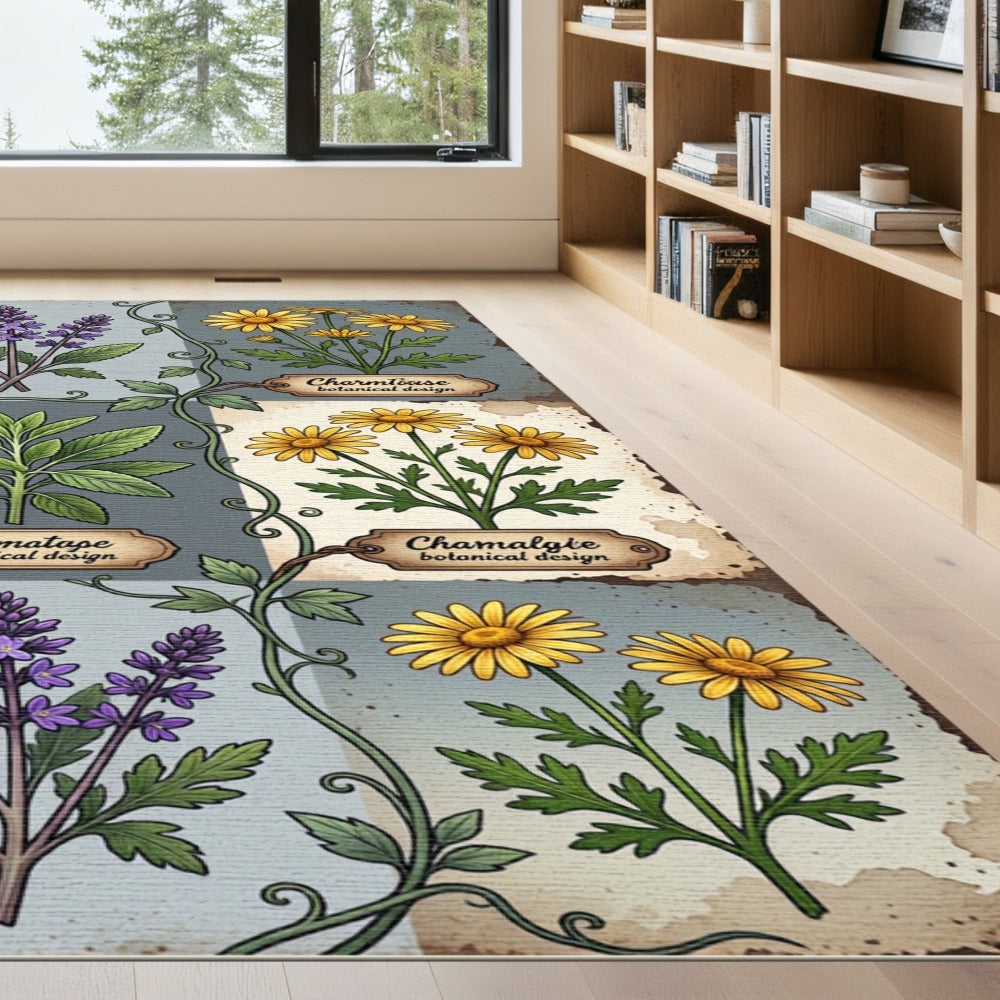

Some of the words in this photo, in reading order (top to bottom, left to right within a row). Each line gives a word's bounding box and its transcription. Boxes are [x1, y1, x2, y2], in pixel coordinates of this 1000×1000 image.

[402, 386, 456, 394] design
[43, 551, 118, 564] design
[420, 551, 529, 561] botanical
[535, 551, 610, 565] design
